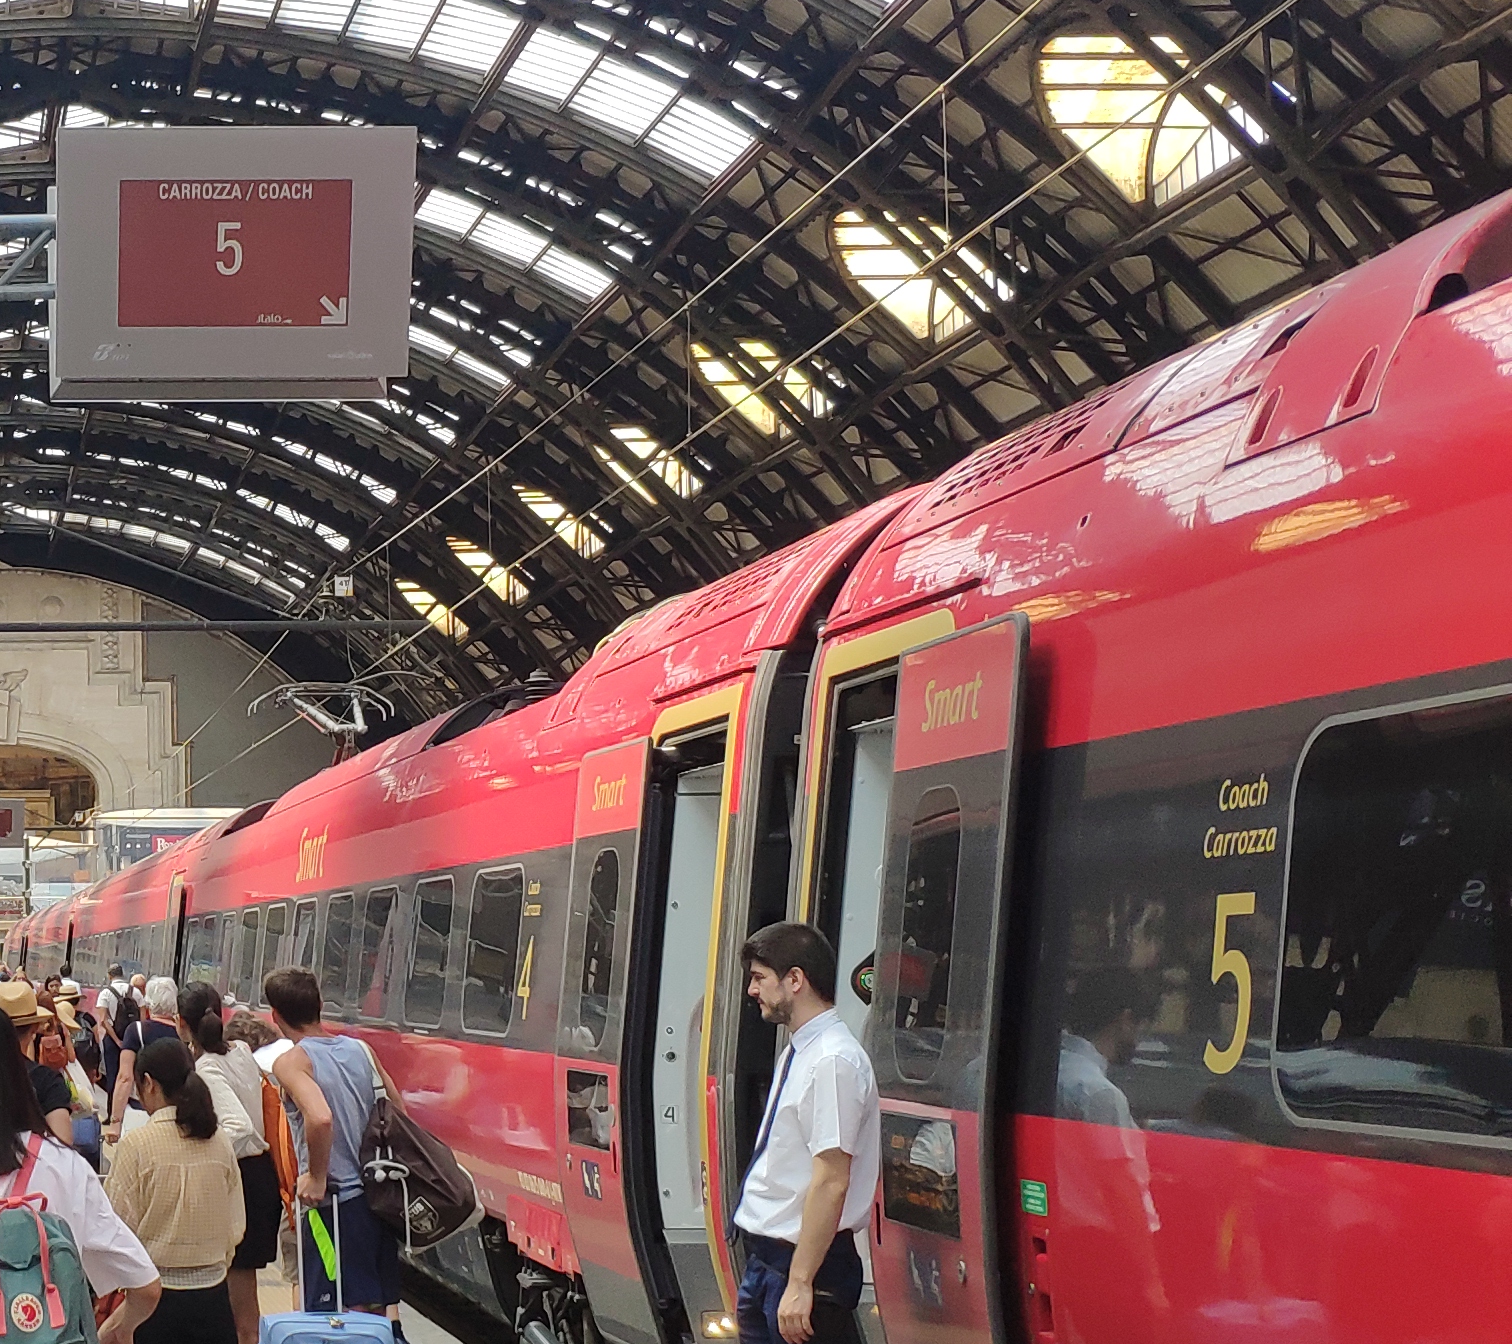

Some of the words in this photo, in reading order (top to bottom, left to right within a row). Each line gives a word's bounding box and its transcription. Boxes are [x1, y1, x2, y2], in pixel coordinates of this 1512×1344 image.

[159, 183, 242, 200] CARROZZA
[245, 182, 255, 201] /
[258, 183, 313, 200] COACH
[216, 222, 243, 276] 5
[921, 670, 983, 732] Smart
[592, 773, 626, 811] Smart
[1219, 772, 1269, 811] Coach
[295, 824, 329, 883] Smart
[1203, 826, 1277, 859] Carrozza
[517, 935, 535, 1021] 4
[1202, 891, 1257, 1075] 5
[664, 1107, 675, 1123] 4
